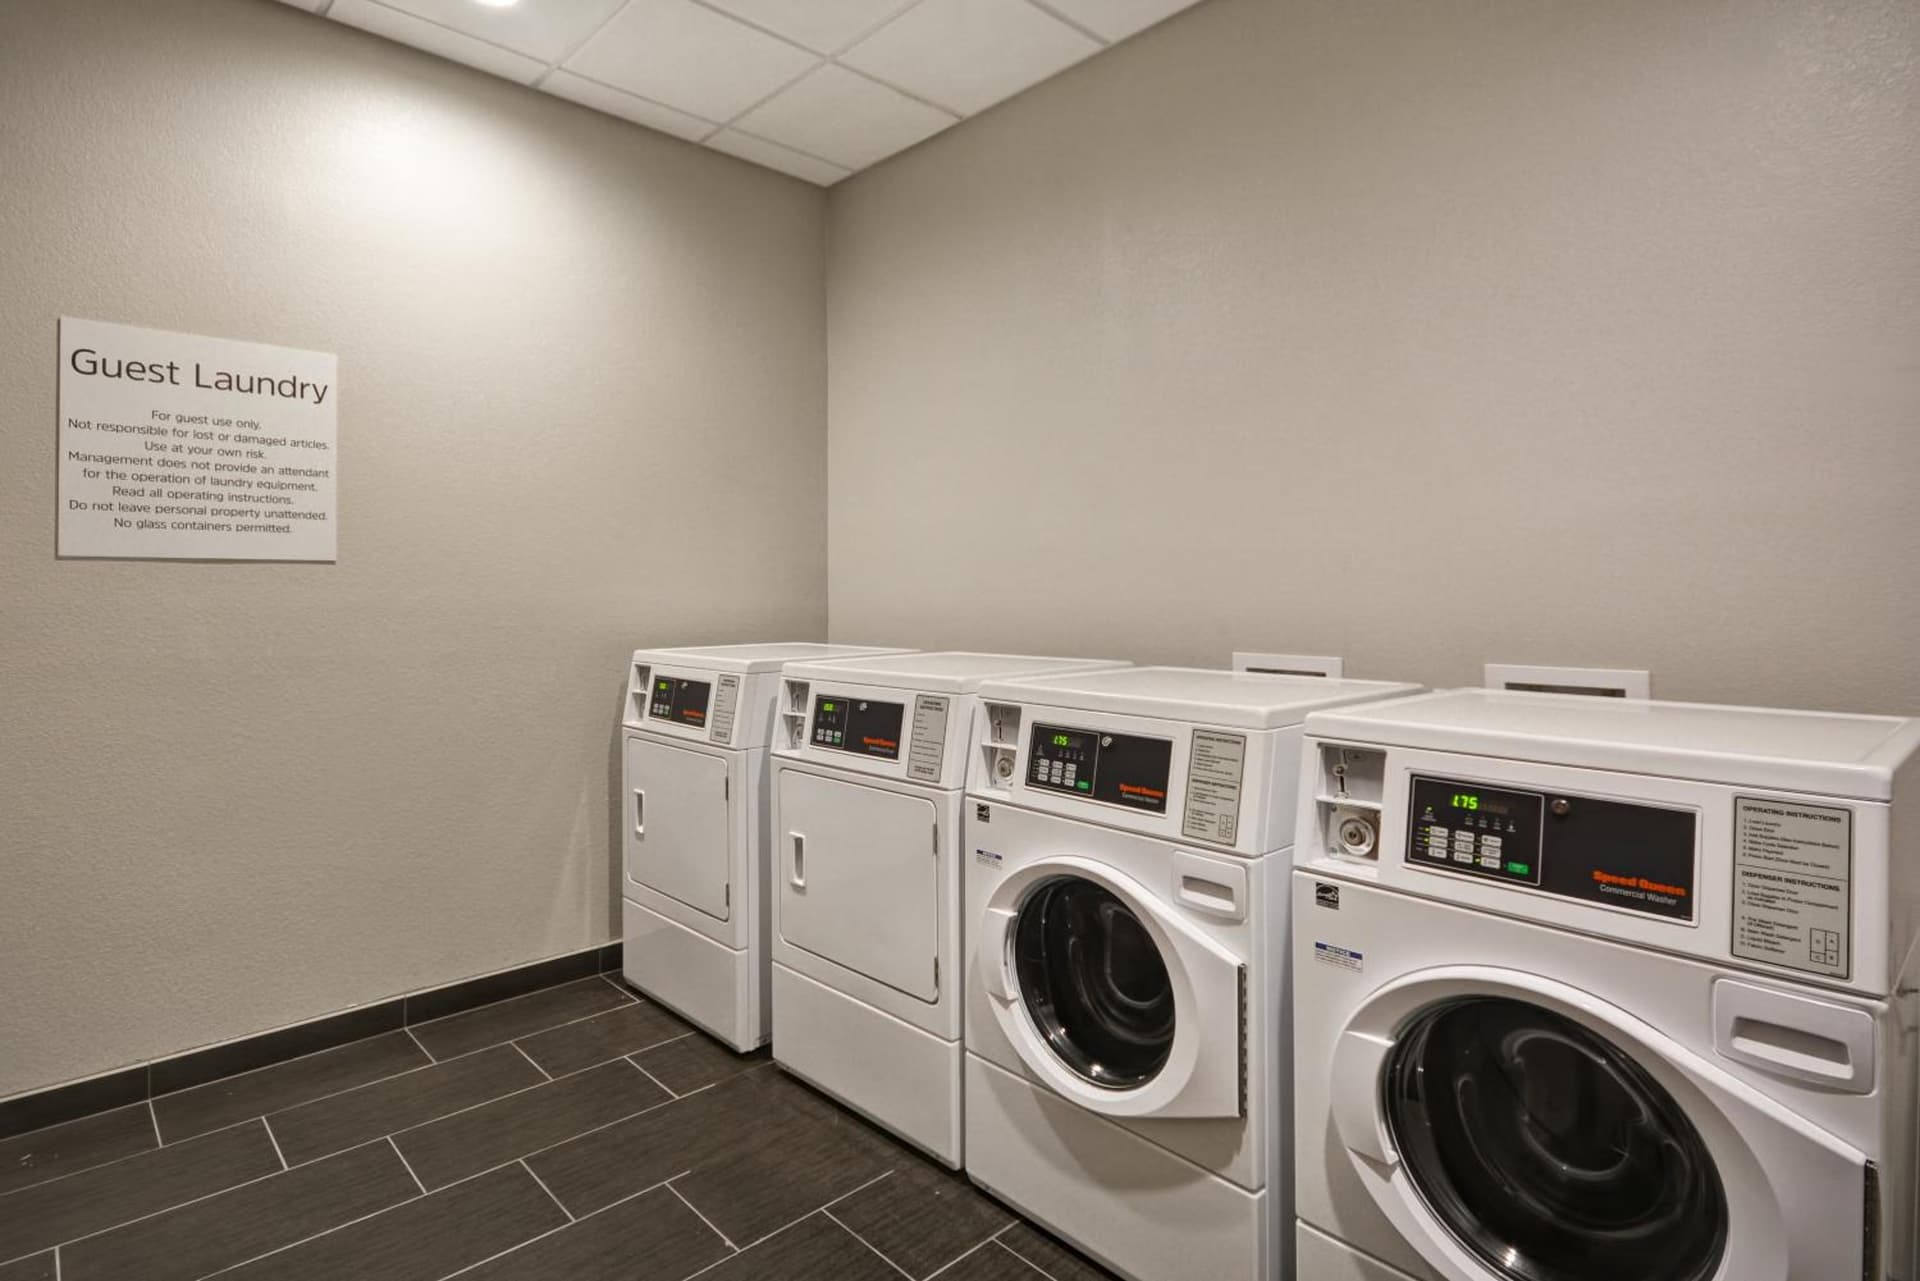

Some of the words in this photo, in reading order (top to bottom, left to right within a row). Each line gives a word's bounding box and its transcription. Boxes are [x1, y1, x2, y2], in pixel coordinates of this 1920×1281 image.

[71, 348, 180, 385] Guest
[195, 363, 328, 404] Laundry
[151, 410, 171, 421] For
[175, 413, 208, 425] guest
[212, 418, 232, 427] use
[236, 419, 262, 431] only.
[68, 418, 92, 430] Not
[96, 422, 168, 436] responsible
[172, 428, 190, 438] for
[193, 429, 214, 440] lost
[218, 433, 230, 441] or
[234, 433, 286, 447] damaged
[290, 439, 330, 450] articles.
[144, 441, 167, 452] Use
[171, 444, 183, 453] at
[187, 446, 213, 455] your
[217, 448, 242, 457] own
[246, 449, 267, 459] risk.
[68, 451, 153, 466] Management
[157, 458, 187, 469] does
[191, 461, 210, 470] not
[214, 463, 257, 474] provide
[260, 465, 275, 475] an
[278, 466, 329, 478] attendant
[83, 468, 101, 479] for
[105, 470, 127, 480] the
[131, 472, 190, 484] operation
[194, 475, 206, 485] of
[210, 475, 253, 489] laundry
[257, 480, 318, 492] equipment.
[112, 486, 145, 497] Read
[149, 488, 163, 498] all
[167, 490, 224, 503] operating
[228, 492, 294, 505] instructions.
[69, 499, 88, 511] Do
[92, 502, 114, 512] not
[118, 502, 151, 513] leave
[155, 505, 207, 516] personal
[211, 507, 261, 519] property
[264, 509, 327, 520] unattended.
[114, 518, 132, 528] No
[136, 519, 167, 530] glass
[171, 521, 232, 532] containers
[236, 523, 292, 533] permitted.
[1743, 805, 1784, 816] OPERATING
[1786, 810, 1841, 823] INSTRUCTIONS
[1593, 870, 1637, 886] Speed
[1639, 878, 1686, 896] Queen
[1741, 870, 1783, 883] DISPENSER
[1784, 877, 1840, 892] INSTRUCTIONS
[1600, 884, 1646, 900] Commercial
[1646, 893, 1677, 906] Washer
